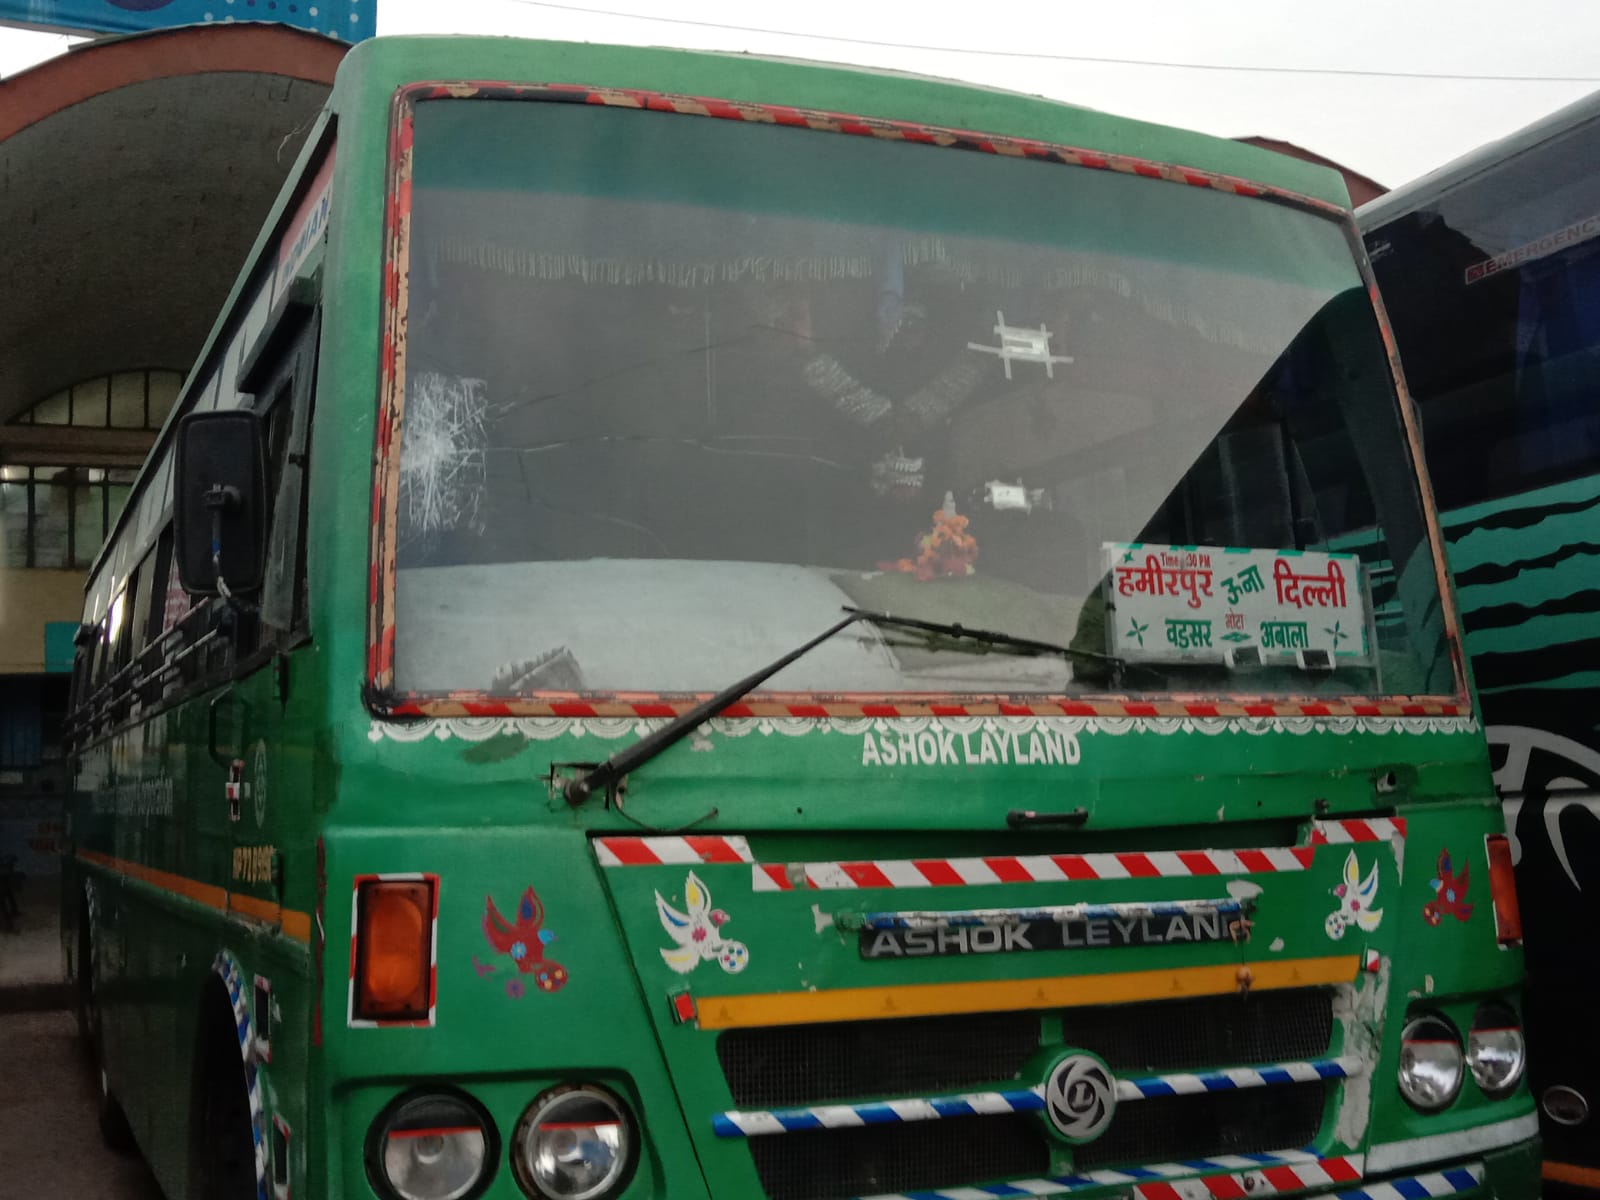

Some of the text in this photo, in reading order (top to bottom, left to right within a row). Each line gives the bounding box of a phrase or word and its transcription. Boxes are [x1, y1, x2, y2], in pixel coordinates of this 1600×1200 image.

[1486, 215, 1600, 273] EMERGENC
[1116, 554, 1347, 609] हमीरपुर ऊना दिल्ली
[862, 731, 1081, 767] ASHOK LAYLAND
[869, 922, 1034, 958] ASHOK
